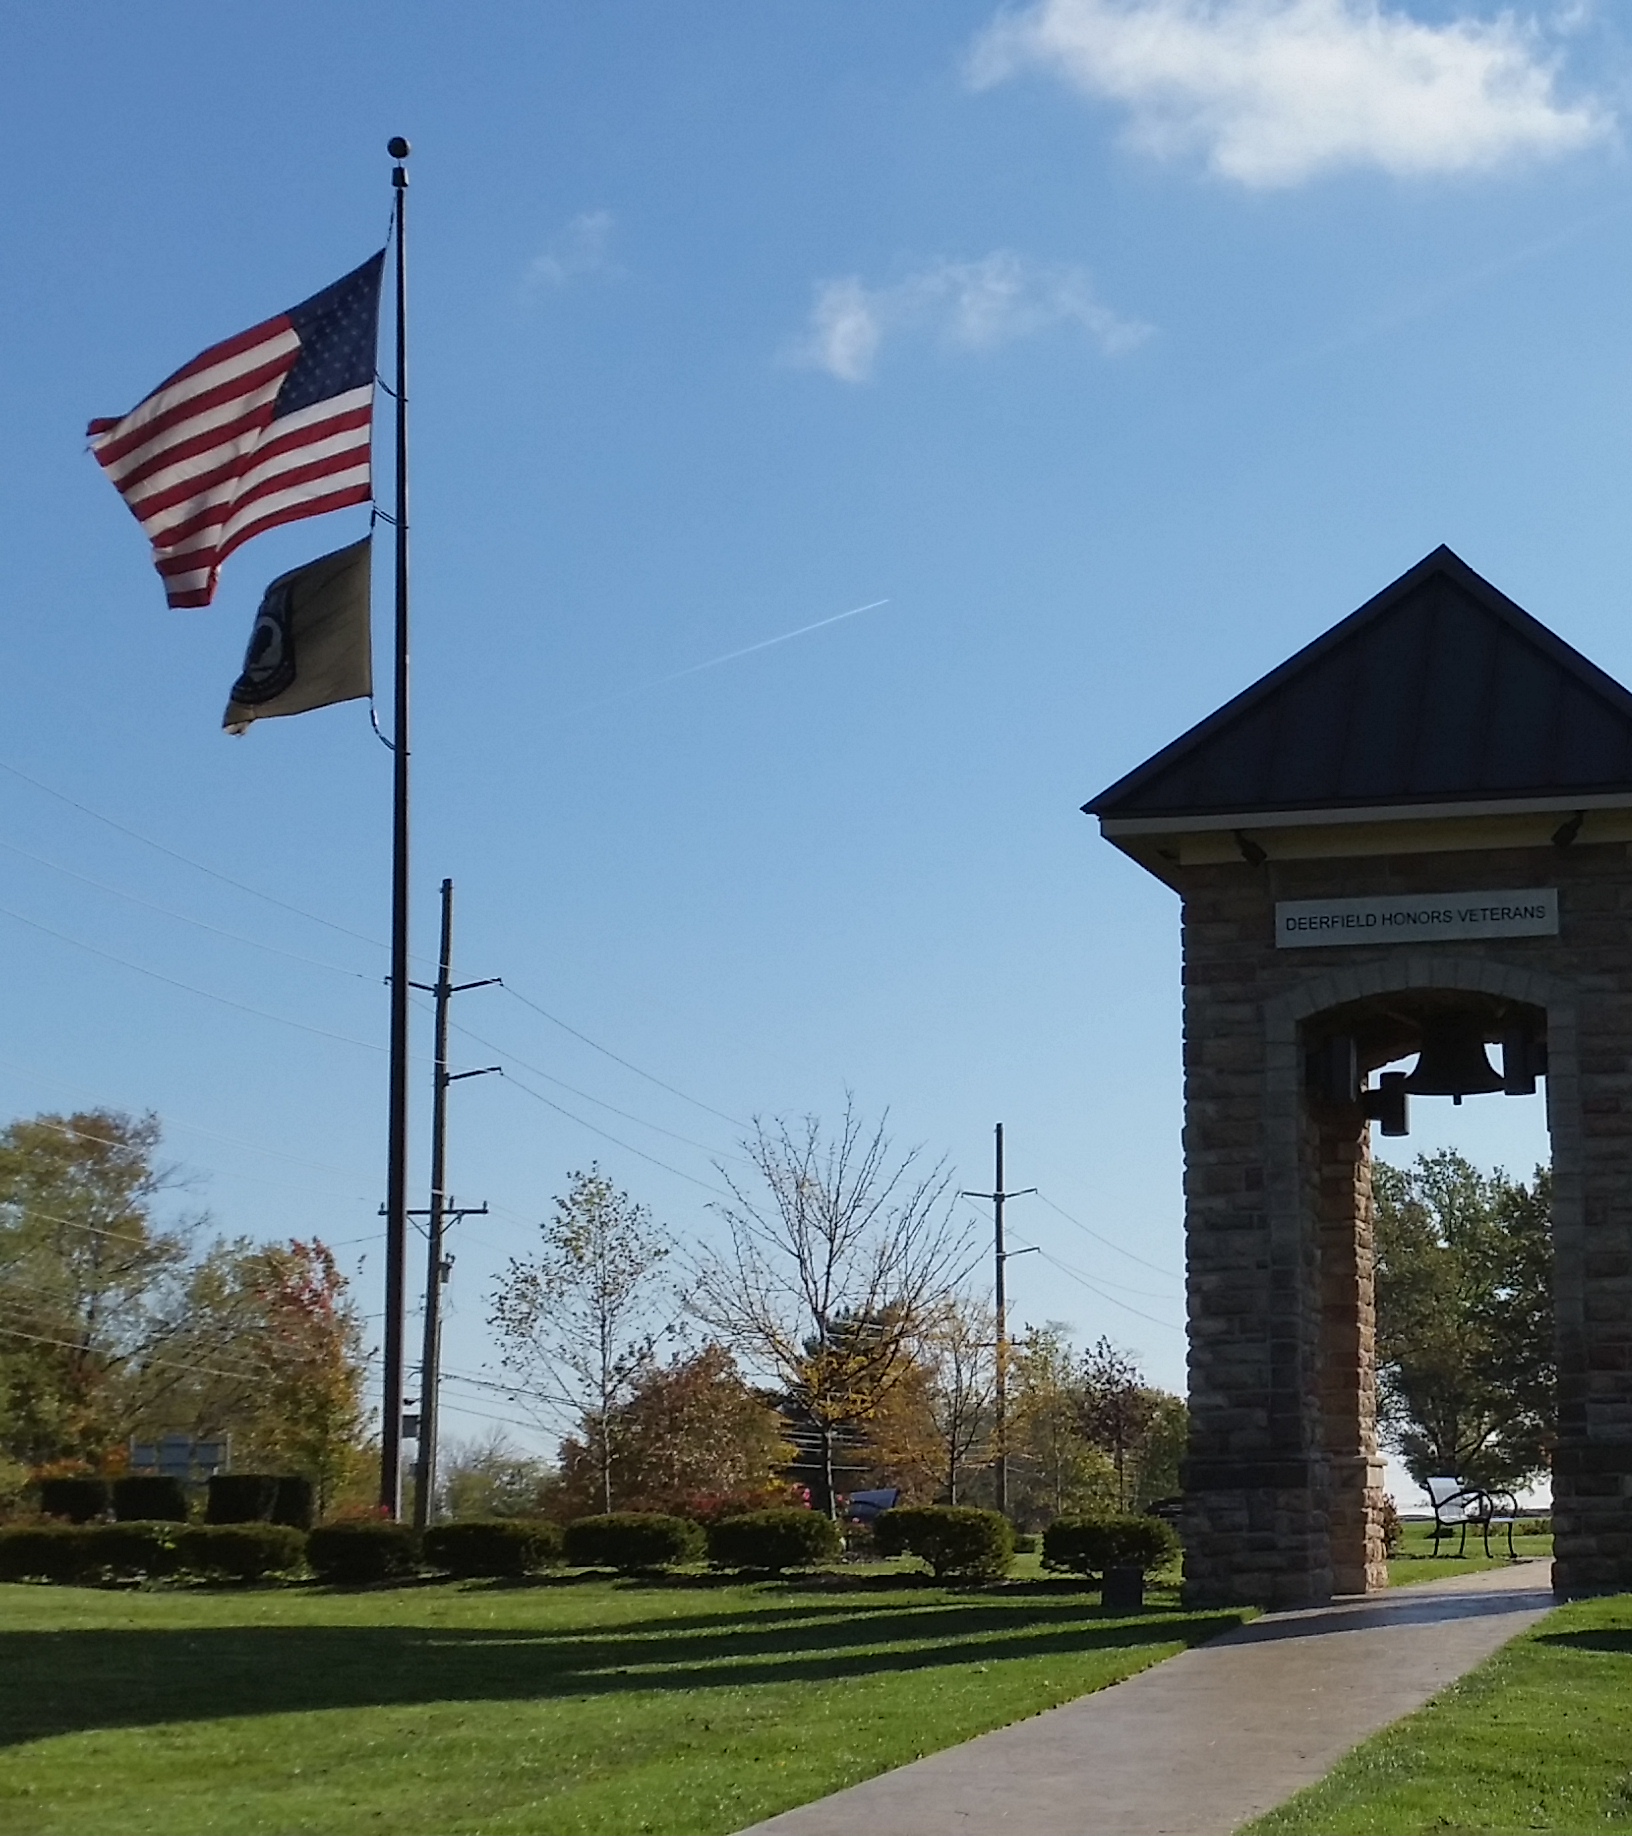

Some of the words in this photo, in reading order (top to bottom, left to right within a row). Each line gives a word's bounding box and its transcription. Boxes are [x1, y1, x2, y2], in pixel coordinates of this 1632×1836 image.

[1285, 913, 1377, 931] DEERFIELD
[1381, 910, 1453, 926] HONORS
[1457, 905, 1546, 922] VETERANS
